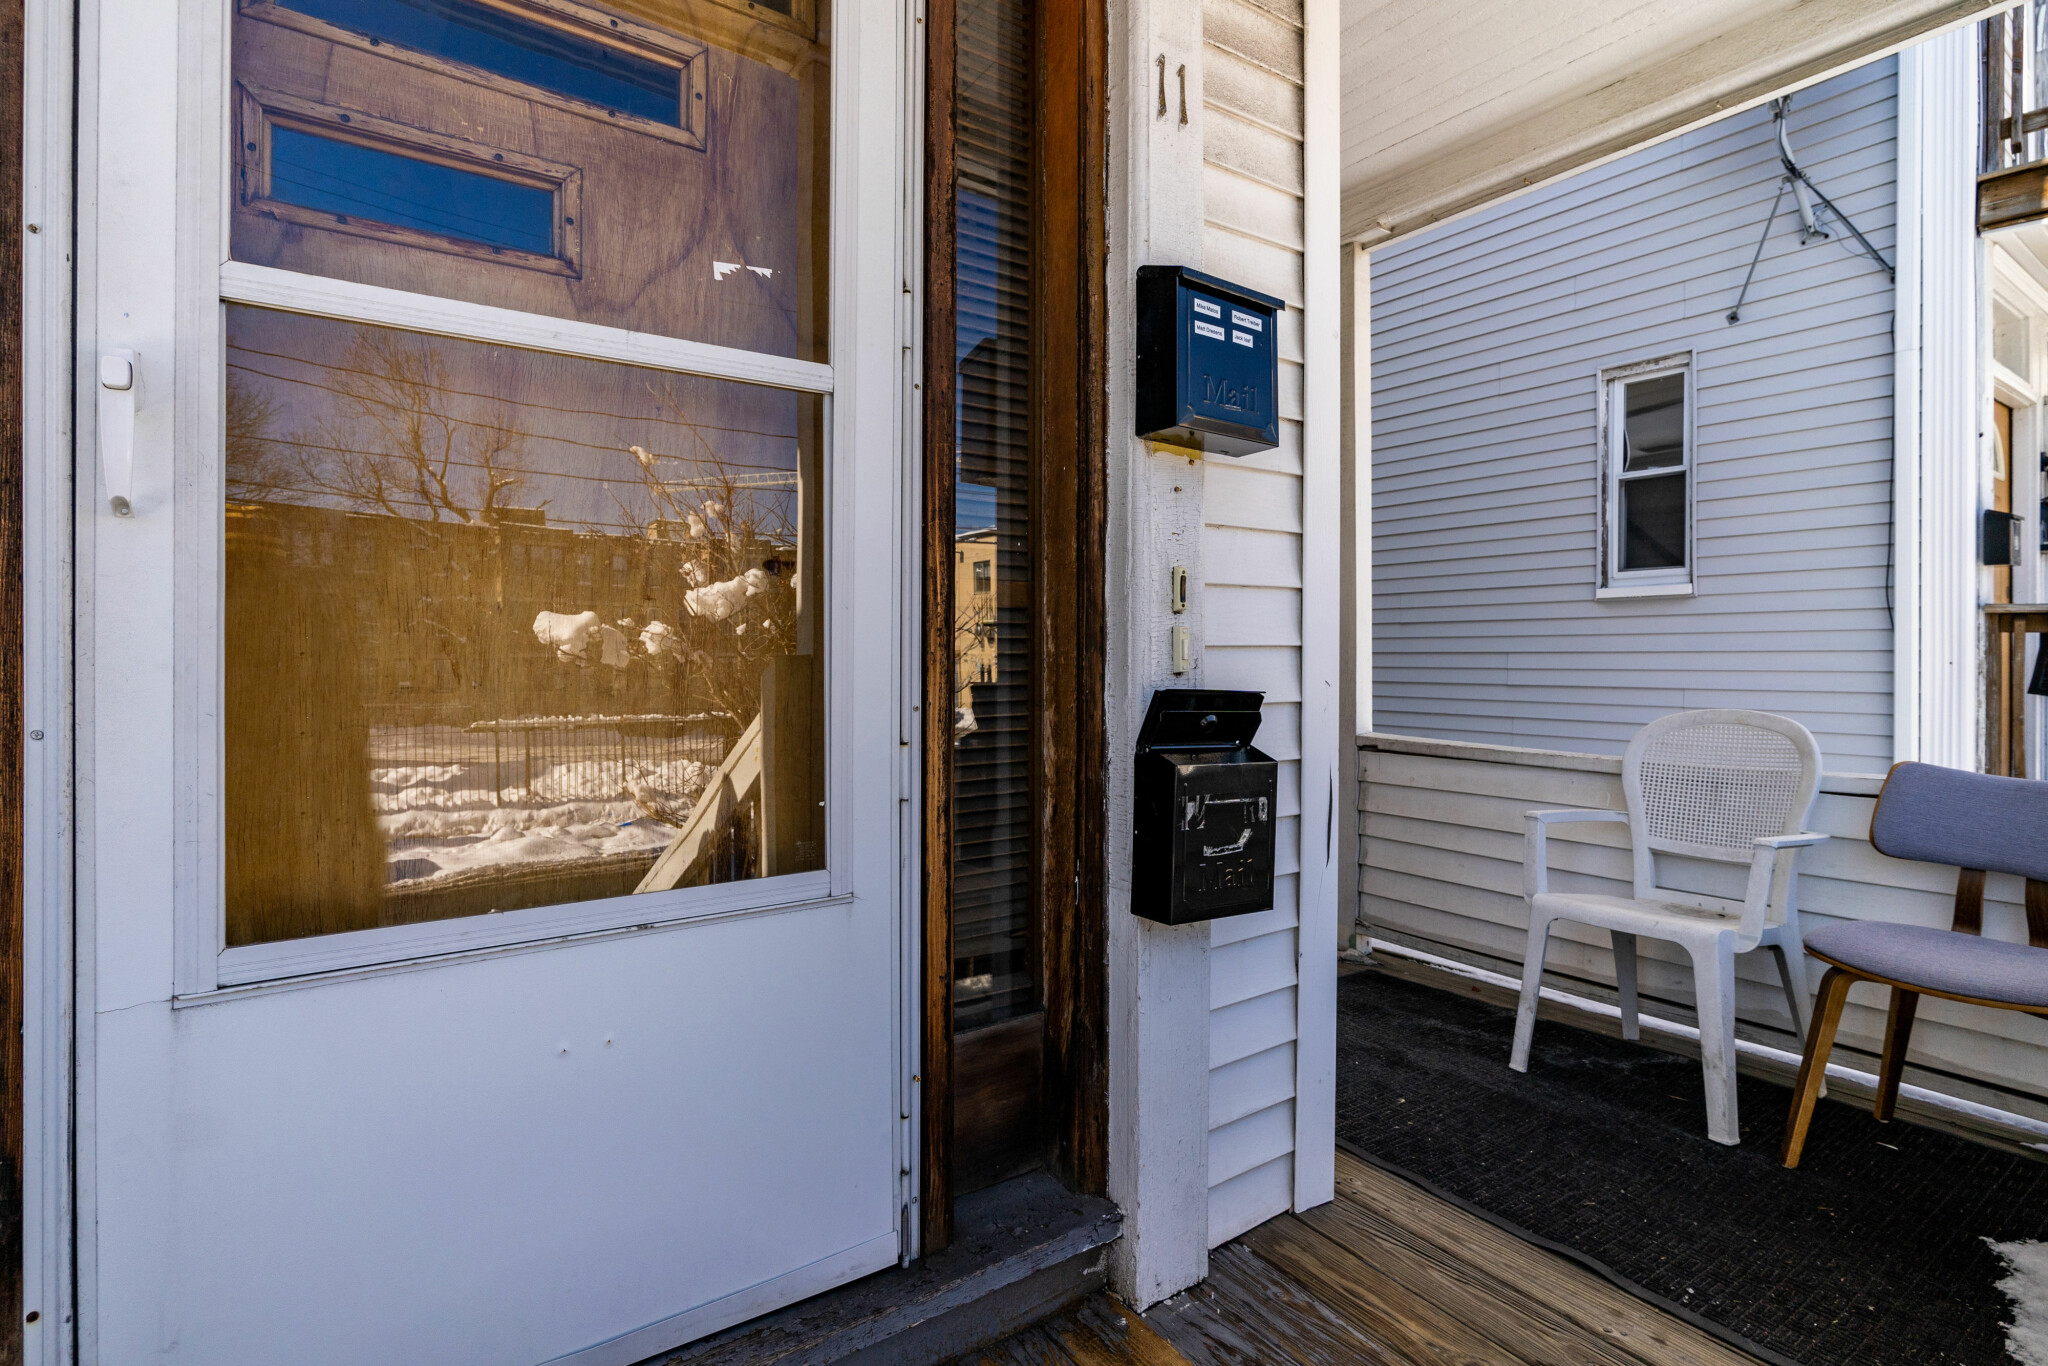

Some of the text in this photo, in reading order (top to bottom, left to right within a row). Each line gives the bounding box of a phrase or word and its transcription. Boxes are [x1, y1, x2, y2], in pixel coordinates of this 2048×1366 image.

[1156, 53, 1188, 126] 11
[1196, 302, 1206, 311] Mike
[1233, 314, 1246, 323] Robert
[1203, 373, 1260, 415] Mail
[1198, 858, 1254, 892] Mail
